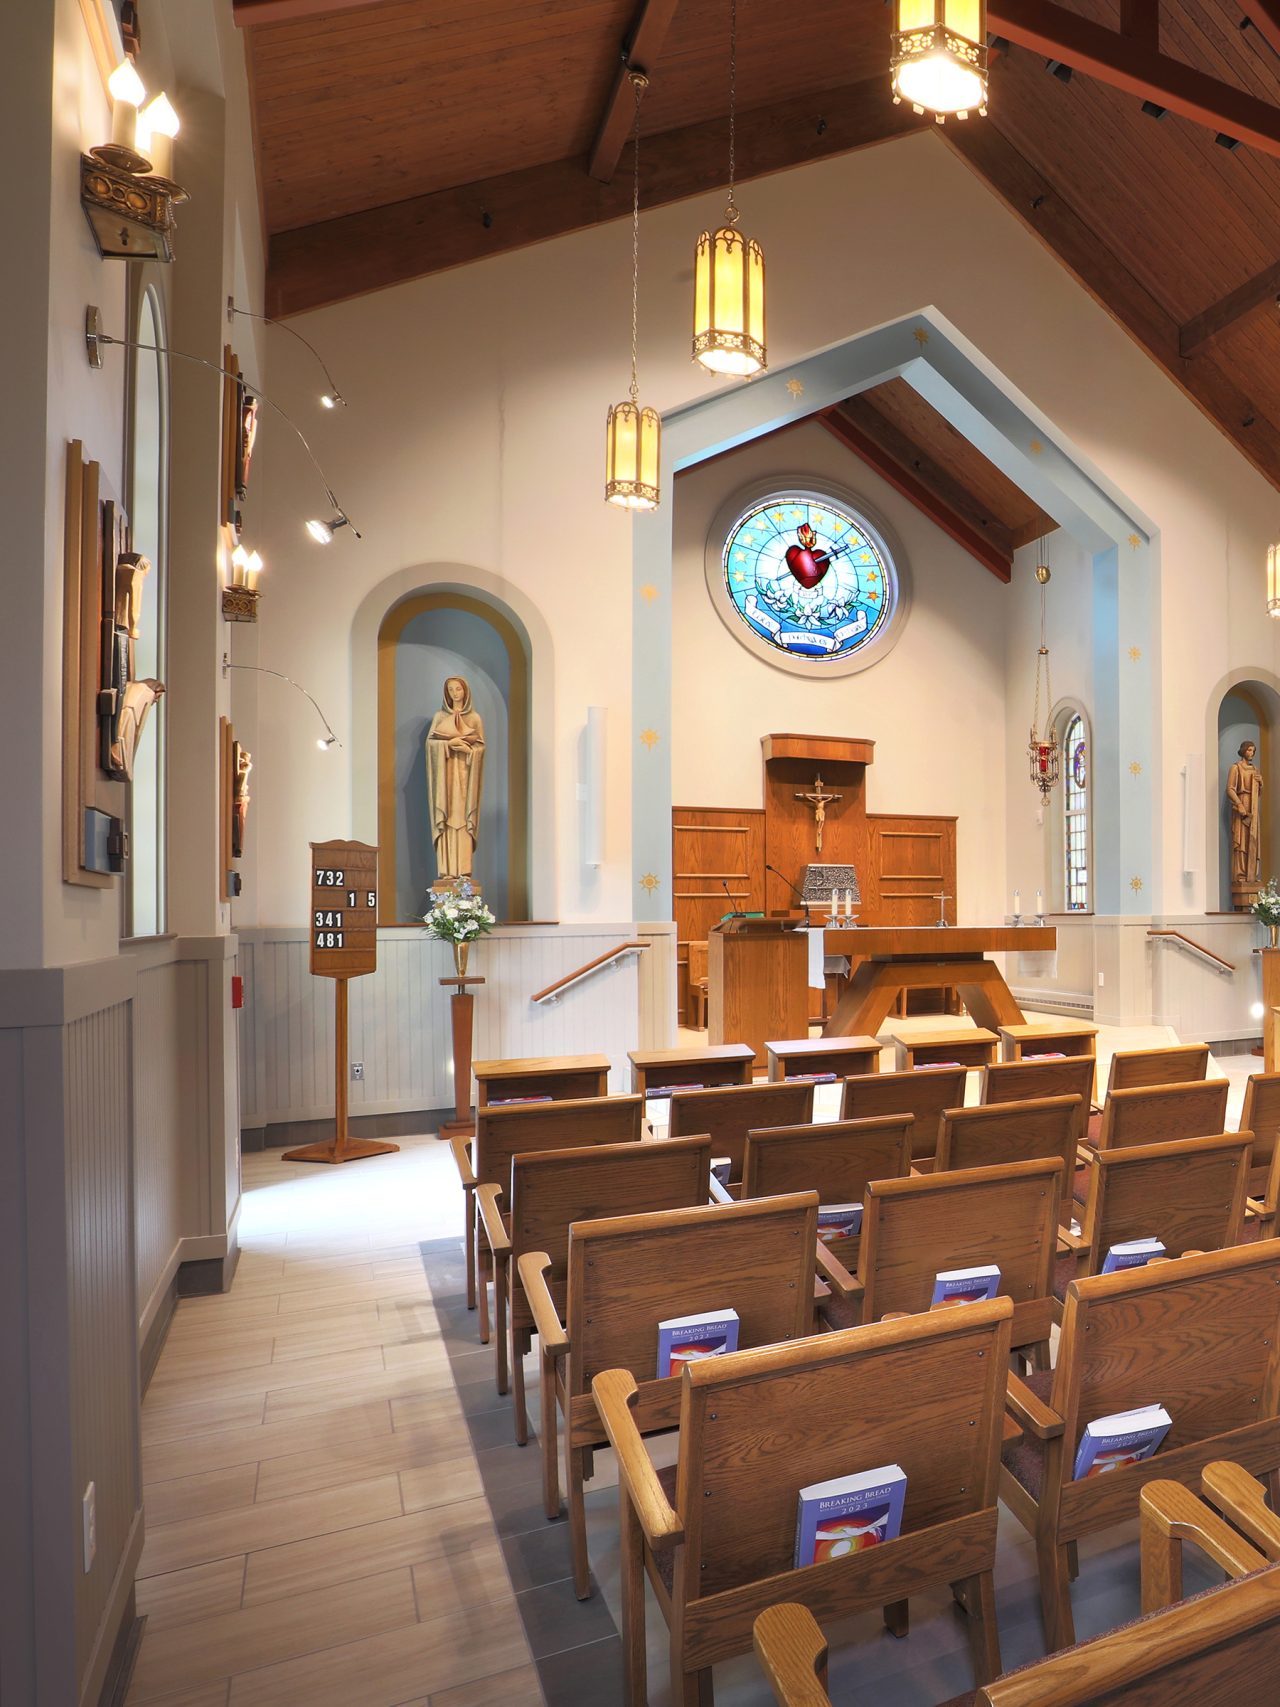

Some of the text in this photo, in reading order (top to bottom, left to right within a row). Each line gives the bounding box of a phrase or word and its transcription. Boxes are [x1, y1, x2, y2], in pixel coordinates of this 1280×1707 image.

[316, 870, 344, 886] 732
[349, 893, 375, 907] 1 5
[315, 912, 342, 927] 341
[316, 933, 343, 948] 481
[671, 1327, 705, 1337] BREAKING
[689, 1333, 710, 1342] 2023
[819, 1494, 863, 1509] BREAKING
[864, 1487, 892, 1499] BREAD
[841, 1502, 868, 1515] 2023
